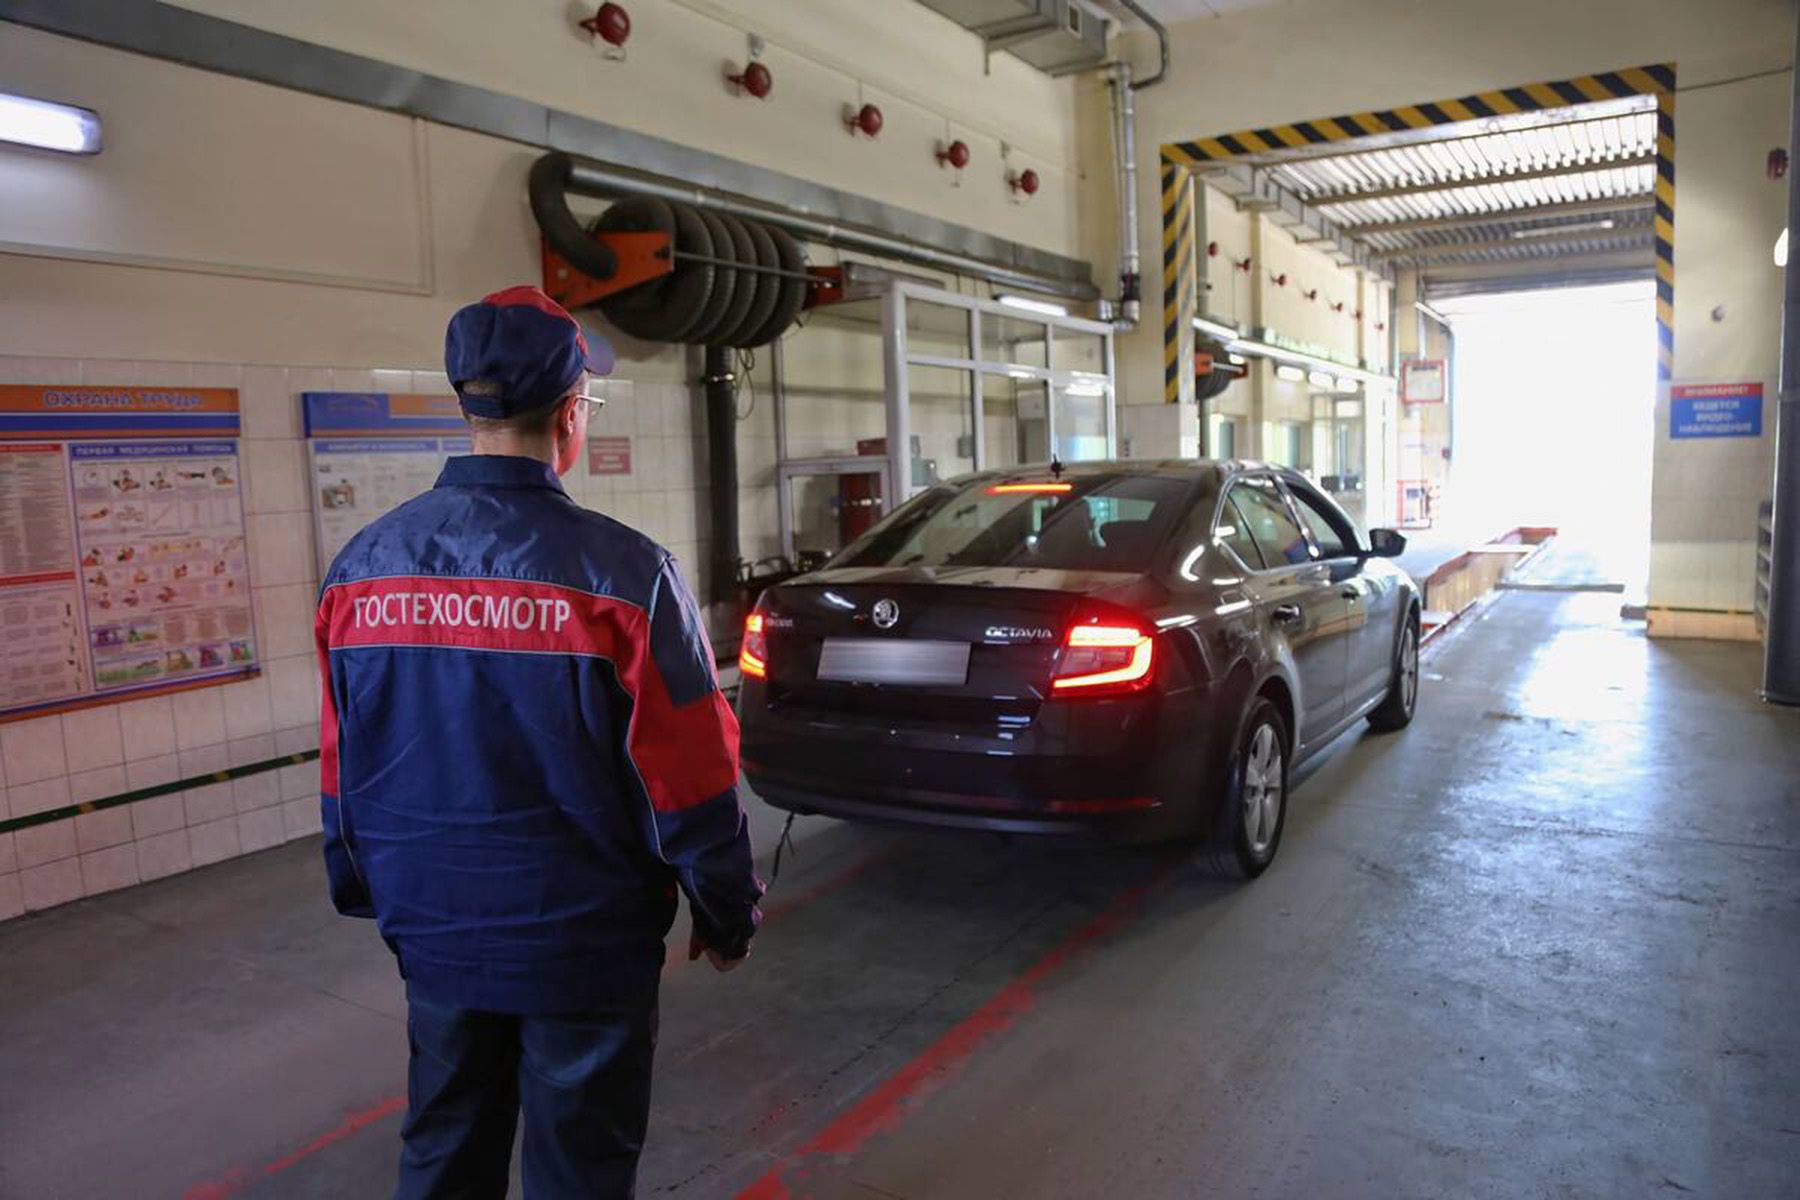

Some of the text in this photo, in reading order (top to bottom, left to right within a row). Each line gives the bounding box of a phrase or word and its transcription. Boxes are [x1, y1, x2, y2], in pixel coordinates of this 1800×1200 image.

[44, 390, 203, 407] ОХРАНА ТРУДА
[353, 592, 571, 633] ГОСТЕХОСМОТР
[985, 626, 1053, 638] OCTAVIA
